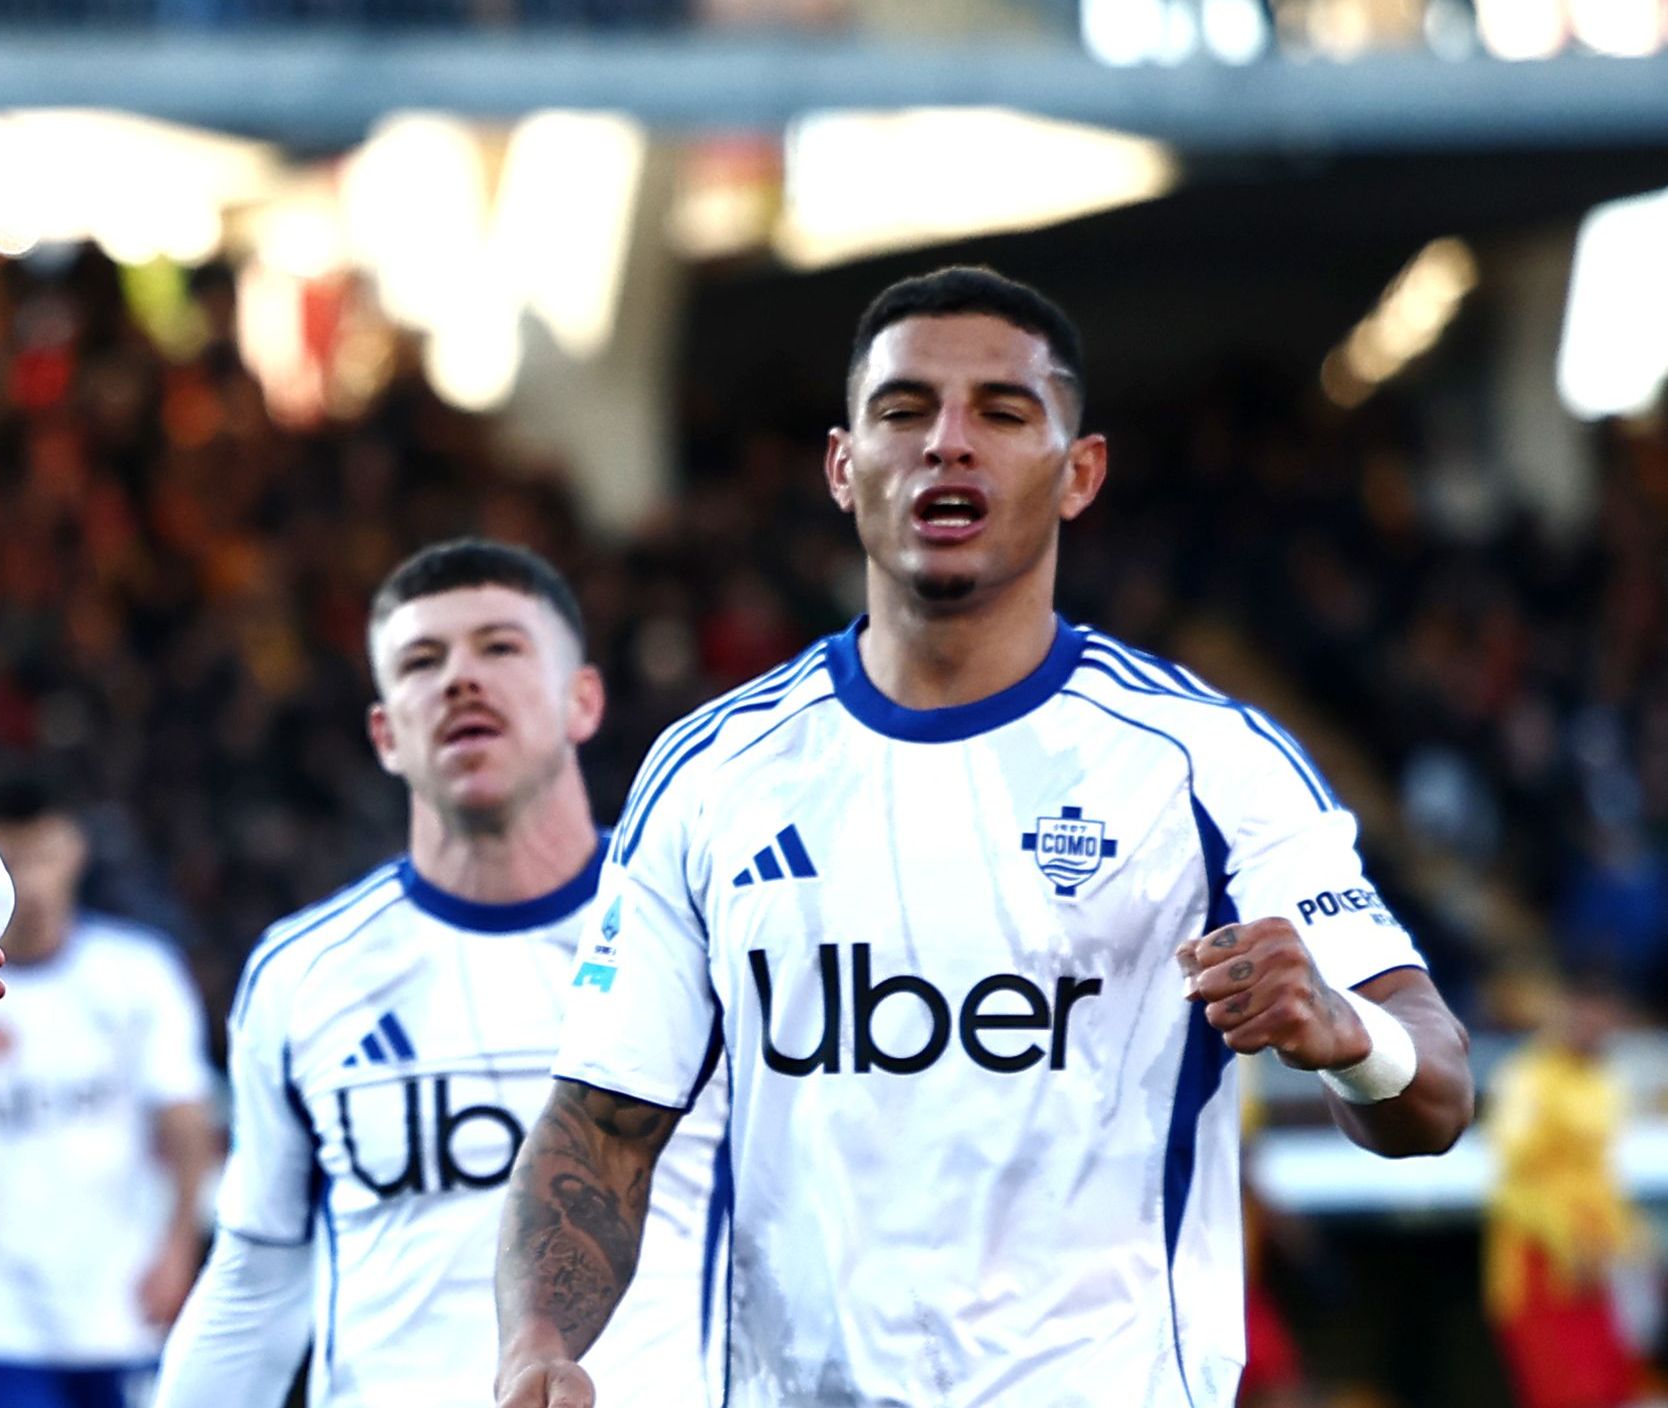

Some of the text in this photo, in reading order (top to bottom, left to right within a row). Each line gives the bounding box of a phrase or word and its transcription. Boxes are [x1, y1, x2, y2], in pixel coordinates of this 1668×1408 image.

[1041, 832, 1098, 857] COMO
[748, 942, 1102, 1076] Uber
[338, 1075, 528, 1199] Ub
